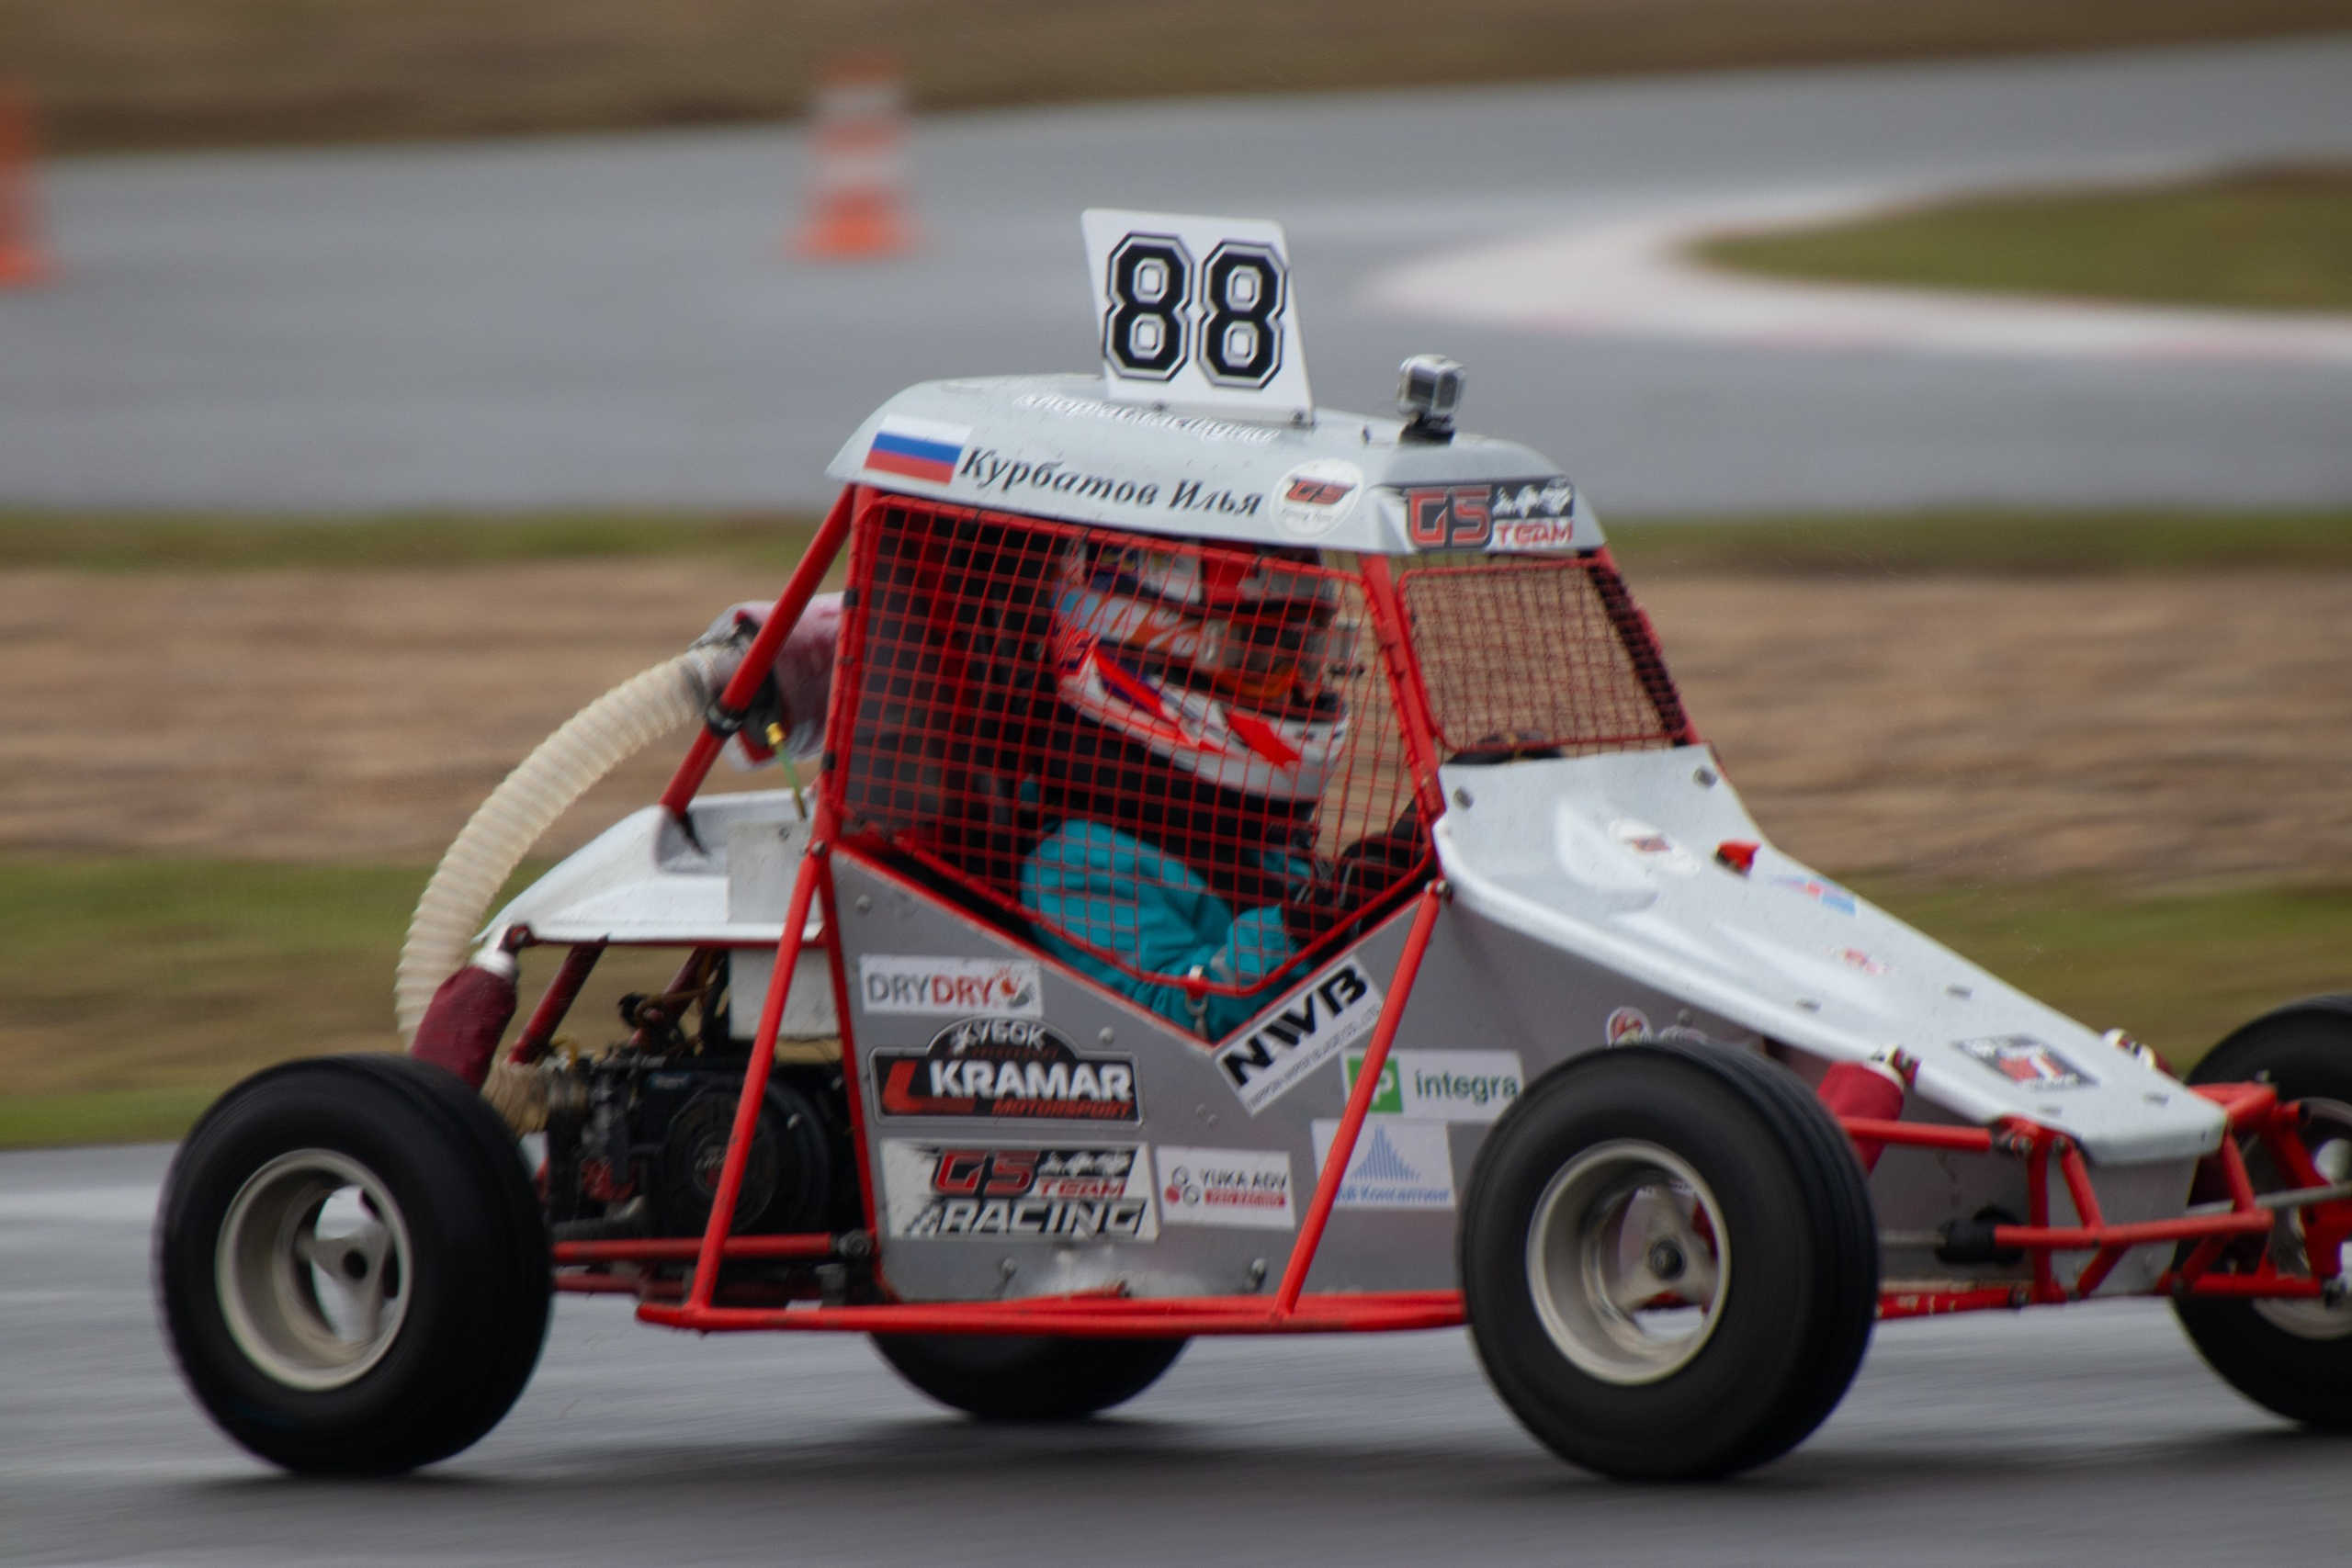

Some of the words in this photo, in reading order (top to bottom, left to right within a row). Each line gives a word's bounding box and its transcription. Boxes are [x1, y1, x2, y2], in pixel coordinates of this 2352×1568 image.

[1102, 231, 1288, 390] 88
[959, 447, 1160, 507] Курбатов
[1166, 477, 1265, 518] Илья
[1495, 521, 1575, 547] TEAM
[866, 972, 996, 1008] DRYDRY
[1223, 965, 1367, 1087] NWB
[929, 1060, 1133, 1101] KRAMAR
[1414, 1068, 1520, 1107] integra
[1039, 1176, 1127, 1200] TEAM
[936, 1196, 1145, 1235] RACING
